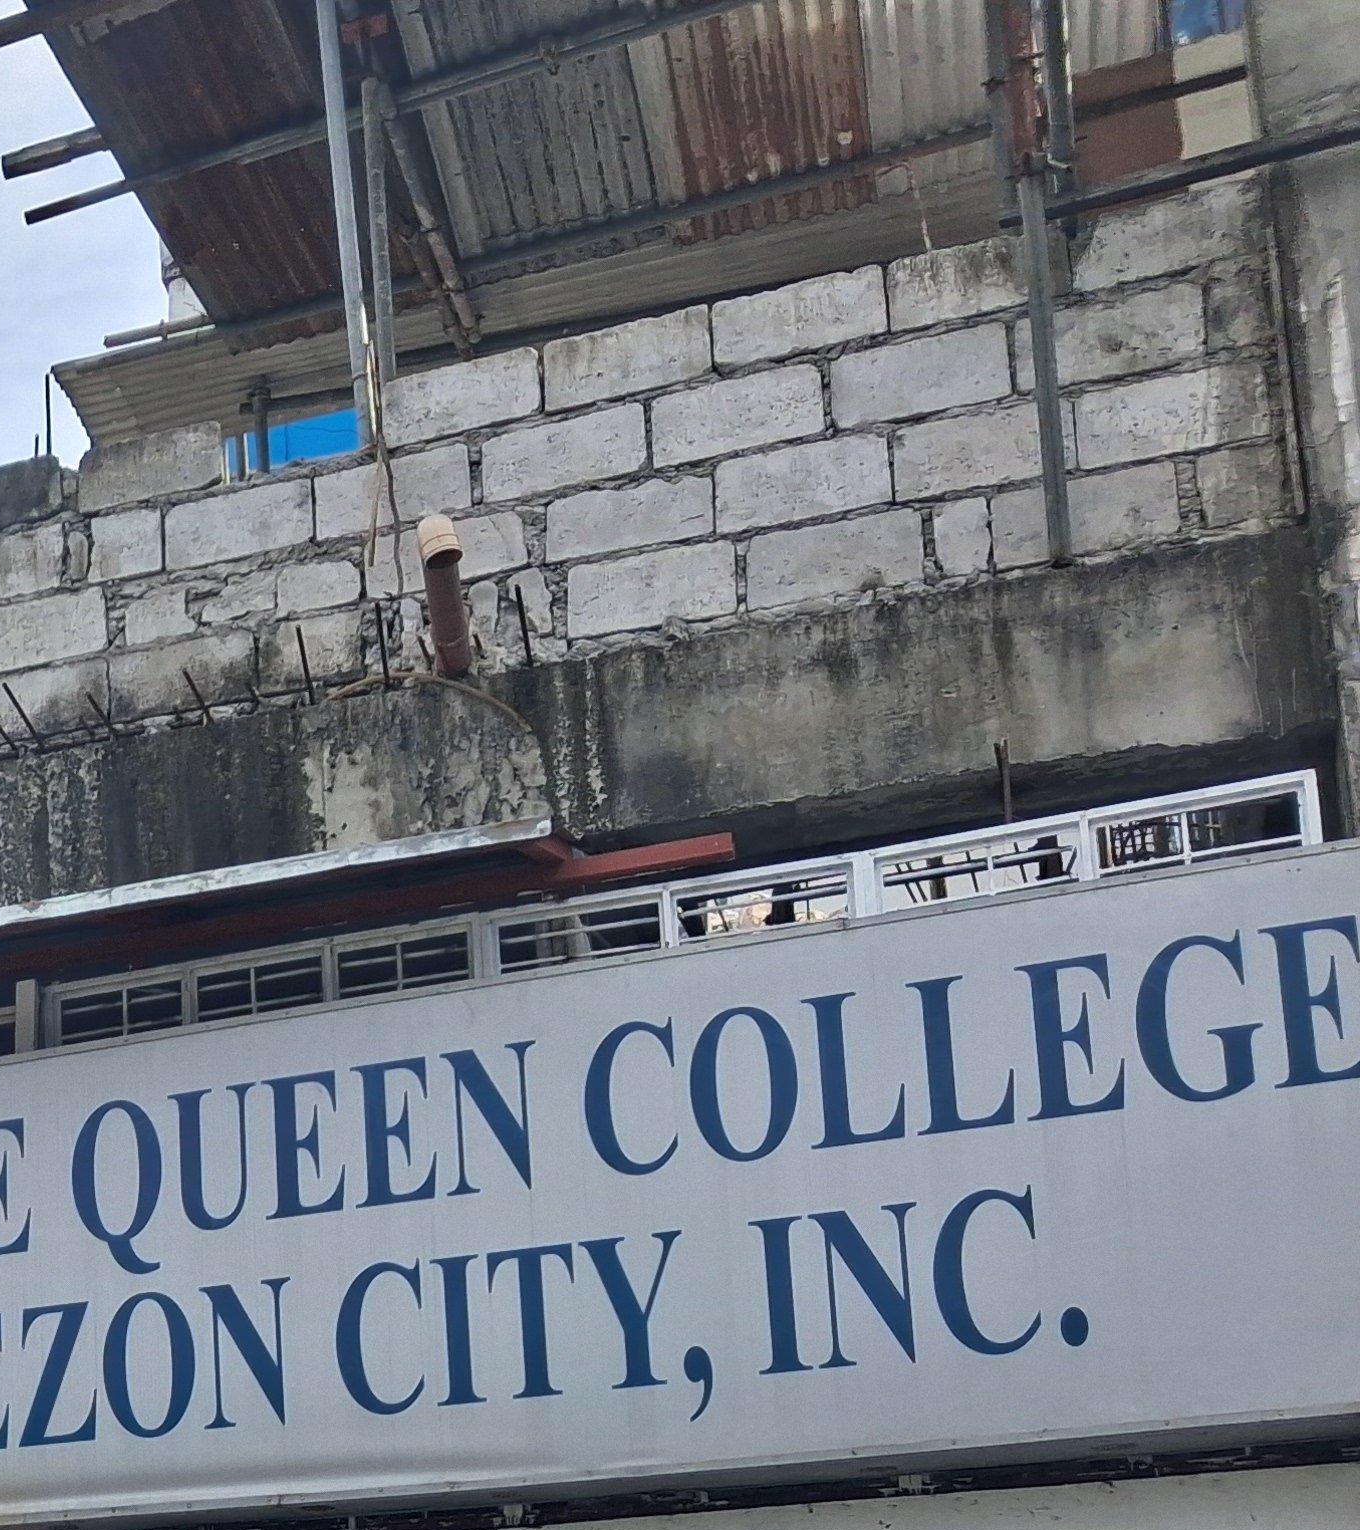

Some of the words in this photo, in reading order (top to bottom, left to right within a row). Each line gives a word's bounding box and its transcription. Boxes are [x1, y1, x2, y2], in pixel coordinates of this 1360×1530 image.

[71, 1039, 537, 1275] QUEEN
[584, 915, 1360, 1176] COLLEGE
[335, 1229, 714, 1423] CITY,
[747, 1183, 1090, 1376] INC.
